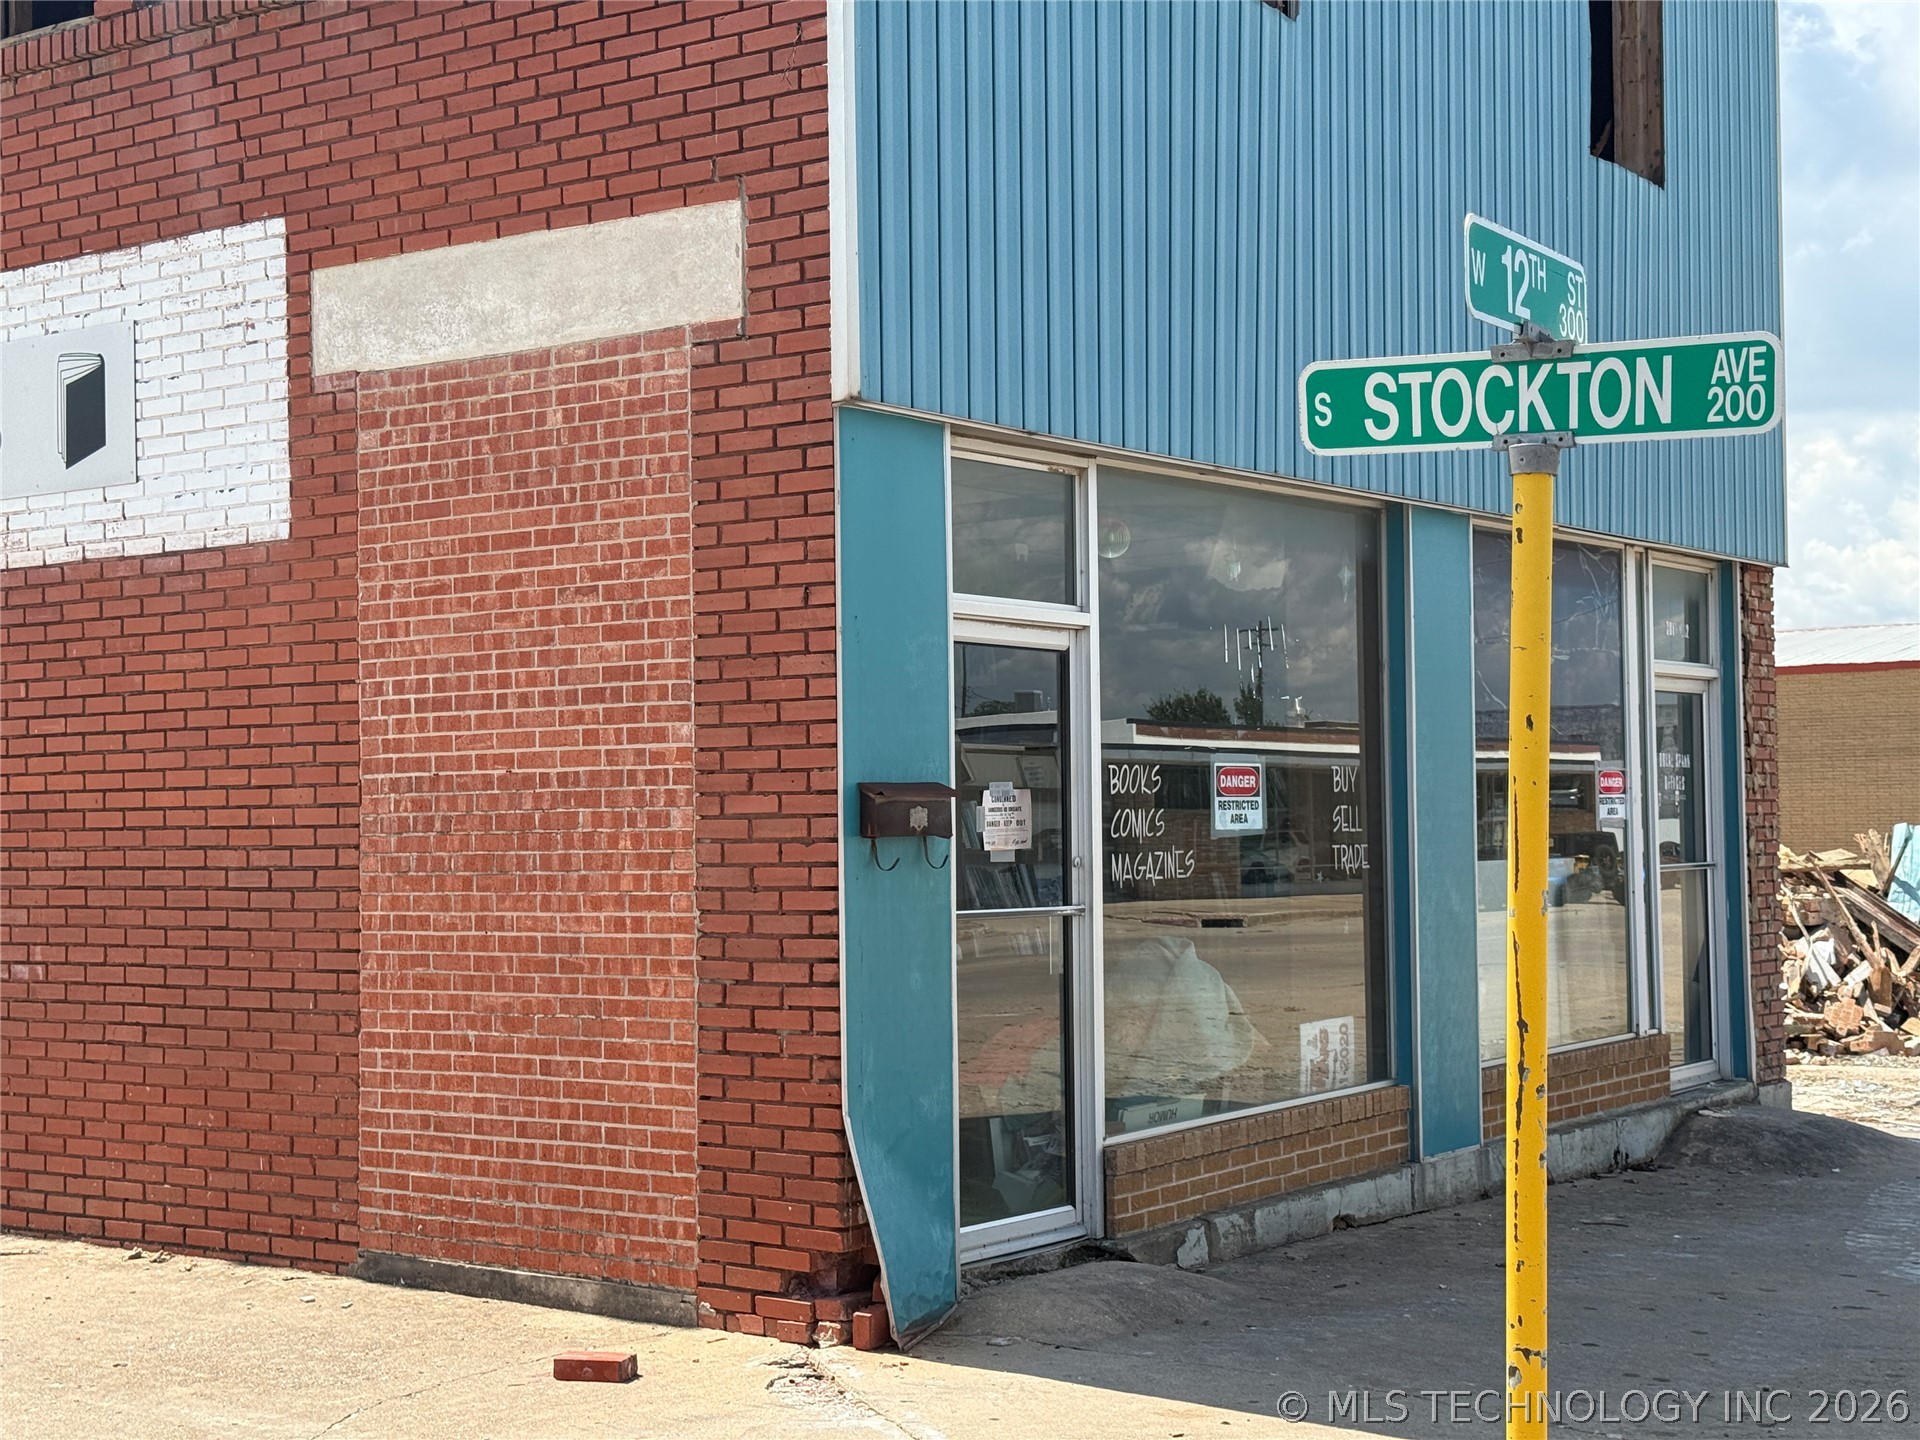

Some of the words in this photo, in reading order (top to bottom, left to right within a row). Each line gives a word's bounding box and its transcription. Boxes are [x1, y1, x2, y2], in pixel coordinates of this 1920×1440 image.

[1471, 247, 1486, 287] W
[1501, 245, 1547, 320] 12TH
[1567, 271, 1583, 308] ST
[1559, 303, 1585, 344] 300
[1314, 392, 1332, 427] S
[1364, 354, 1673, 441] STOCKTON
[1711, 345, 1767, 384] AVE
[1707, 383, 1767, 423] 200
[1108, 764, 1162, 795] BOOKS
[1220, 775, 1256, 788] DANGER
[1331, 765, 1358, 793] BUY
[1600, 776, 1623, 787] DANGER
[1218, 800, 1259, 811] RESTRICTED
[1599, 796, 1625, 805] RESTRICTED
[1607, 808, 1619, 816] AREA
[1110, 808, 1165, 844] COMICS
[1230, 813, 1249, 825] AREA
[1332, 805, 1363, 832] SELL
[1111, 846, 1195, 888] MAGAZINES
[1332, 844, 1370, 875] TRADE
[1148, 1107, 1178, 1124] HUMOR
